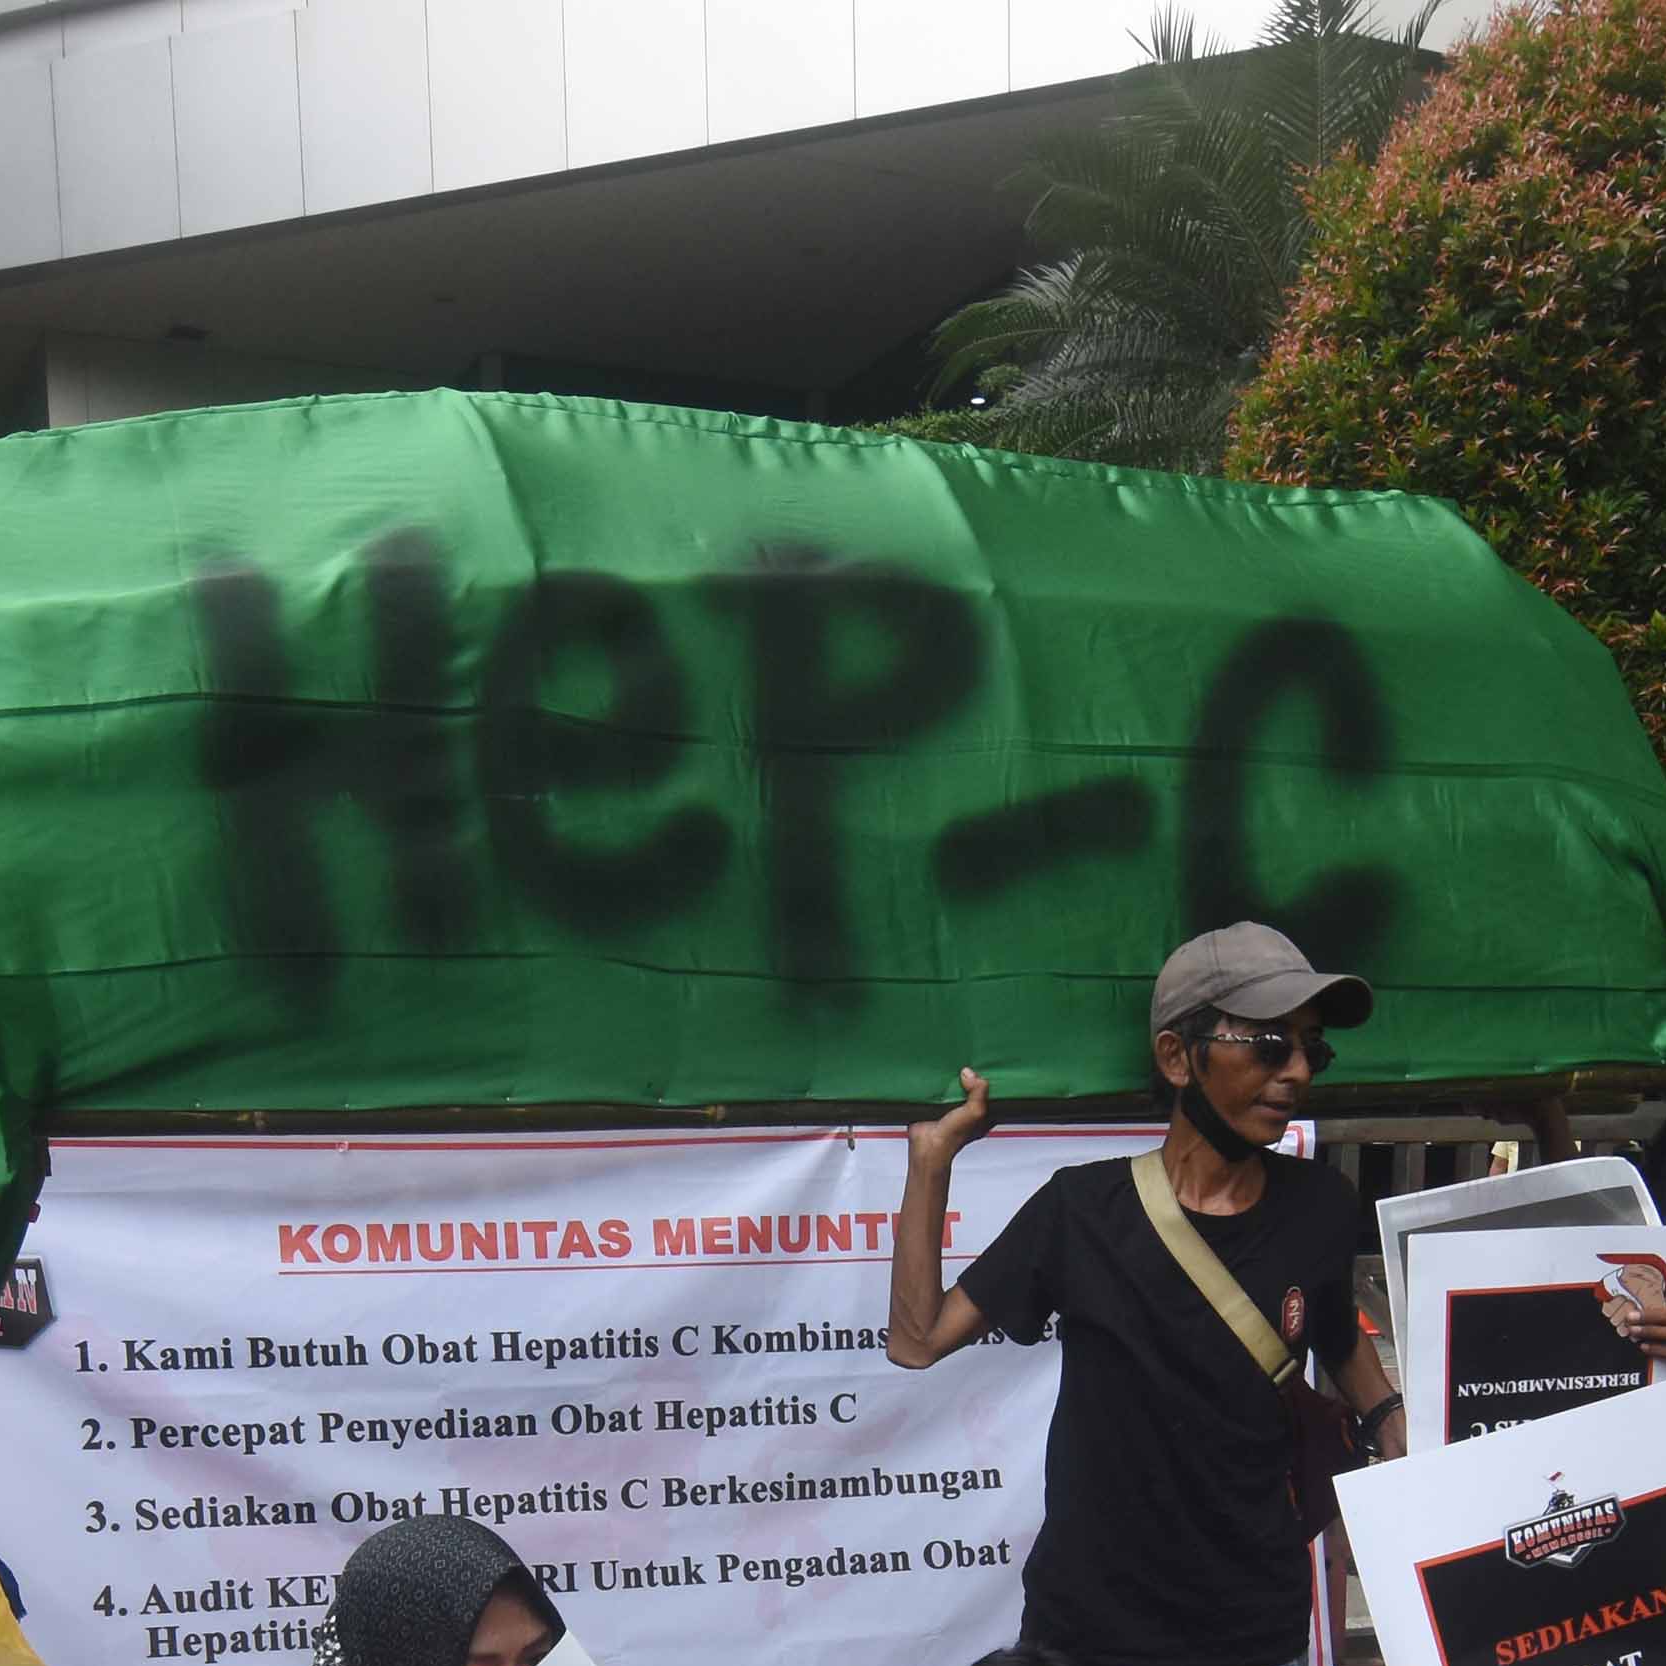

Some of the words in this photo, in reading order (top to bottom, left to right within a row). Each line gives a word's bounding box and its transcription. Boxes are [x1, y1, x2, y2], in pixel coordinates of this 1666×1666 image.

[278, 1219, 632, 1263] KOMUNITAS
[653, 1212, 960, 1257] MENUNTT
[75, 1341, 108, 1372] 1.
[123, 1337, 234, 1372] Kami
[247, 1335, 368, 1369] Butuh
[383, 1333, 477, 1365] Obat
[491, 1327, 659, 1369] Hepatitis
[672, 1325, 699, 1356] C
[713, 1321, 890, 1355] Kombinas
[1458, 1373, 1640, 1398] BERKESINAMBUNGAN
[80, 1419, 116, 1450] 2.
[130, 1415, 305, 1455] Percepat
[319, 1408, 537, 1449] Penyediaan
[551, 1402, 643, 1435] Obat
[654, 1396, 817, 1437] Hepatitis
[830, 1393, 857, 1423] C
[85, 1501, 120, 1532] 3.
[135, 1496, 317, 1531] Sediakan
[332, 1491, 427, 1523] Obat
[440, 1482, 607, 1526] Hepatitis
[621, 1478, 649, 1509] C
[662, 1466, 1002, 1509] Berkesinambungan
[1511, 1502, 1617, 1553] KOMUNITAS
[93, 1585, 127, 1617] 4.
[140, 1580, 254, 1614] Audit
[592, 1557, 706, 1591] Untuk
[718, 1547, 910, 1588] Pengadaan
[923, 1539, 1011, 1570] Obat
